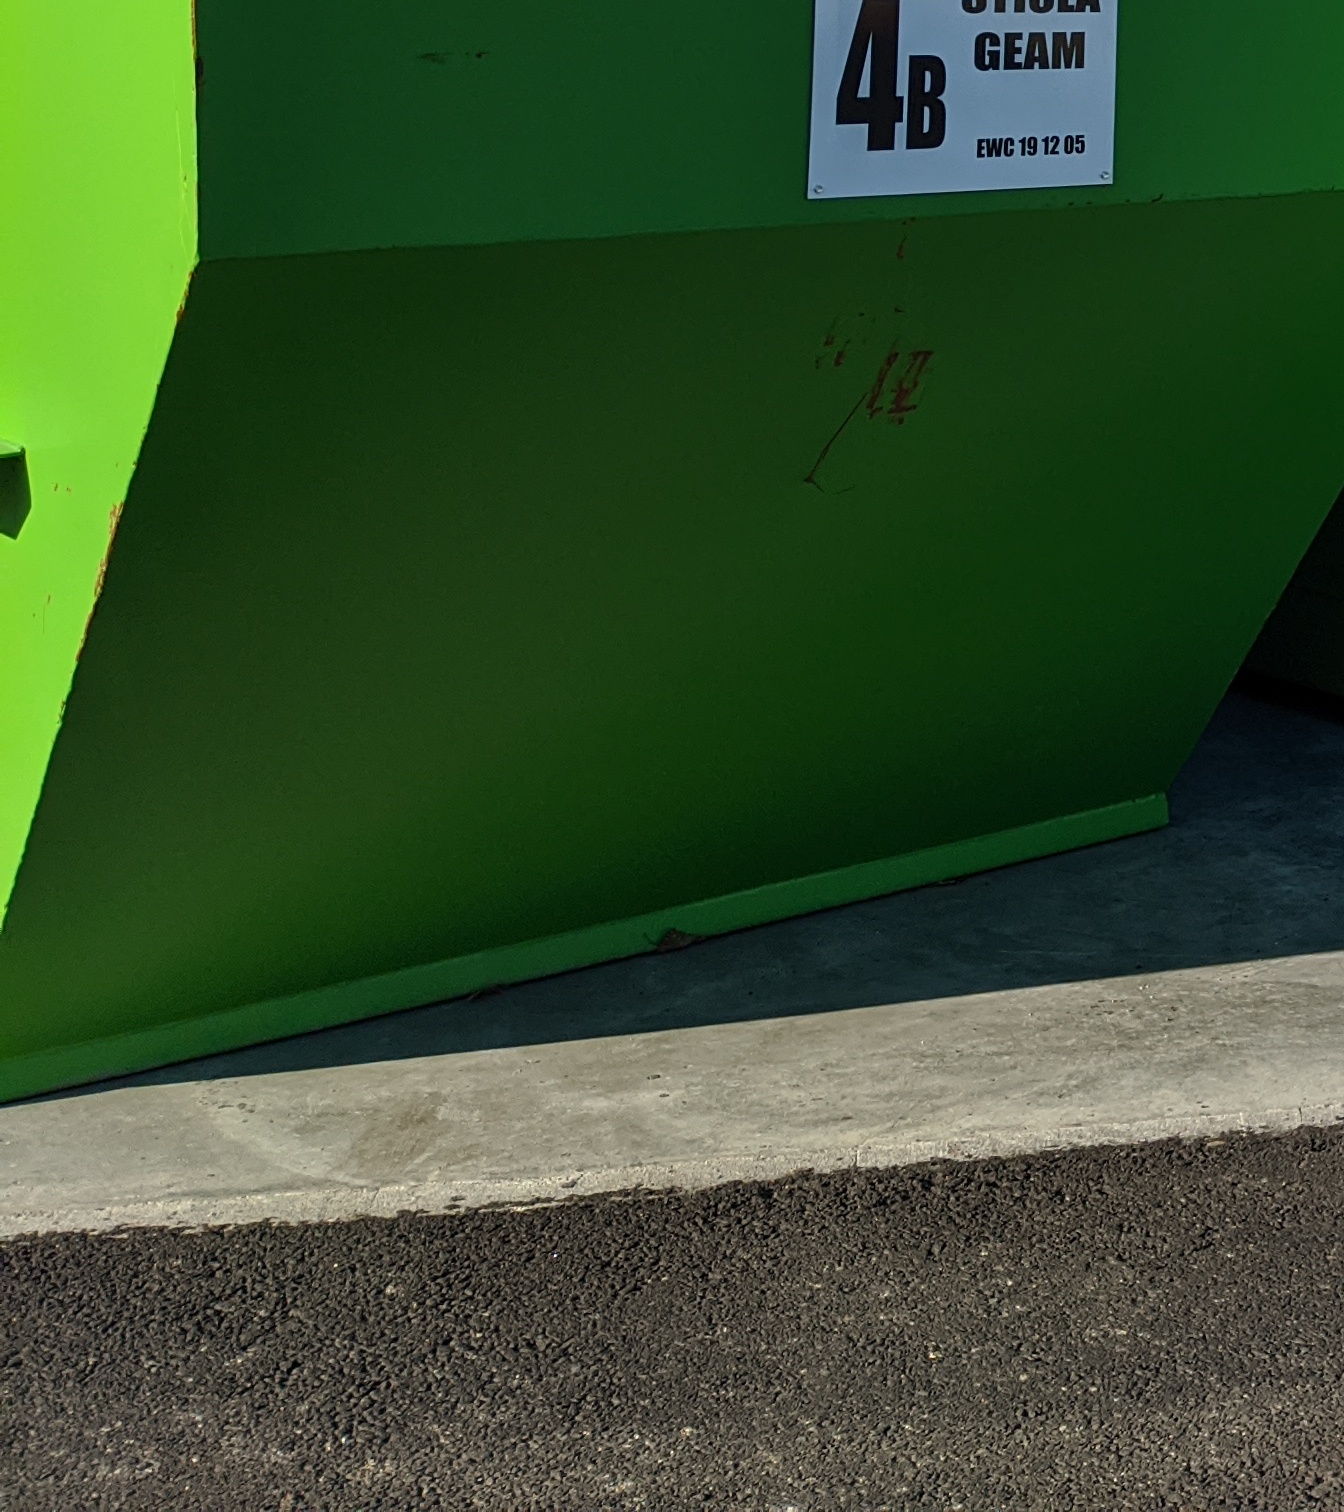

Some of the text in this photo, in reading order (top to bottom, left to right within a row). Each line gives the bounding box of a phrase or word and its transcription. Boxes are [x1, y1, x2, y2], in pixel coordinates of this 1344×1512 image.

[973, 31, 1086, 72] GEAM
[976, 134, 1086, 158] EWC 19 12 05
